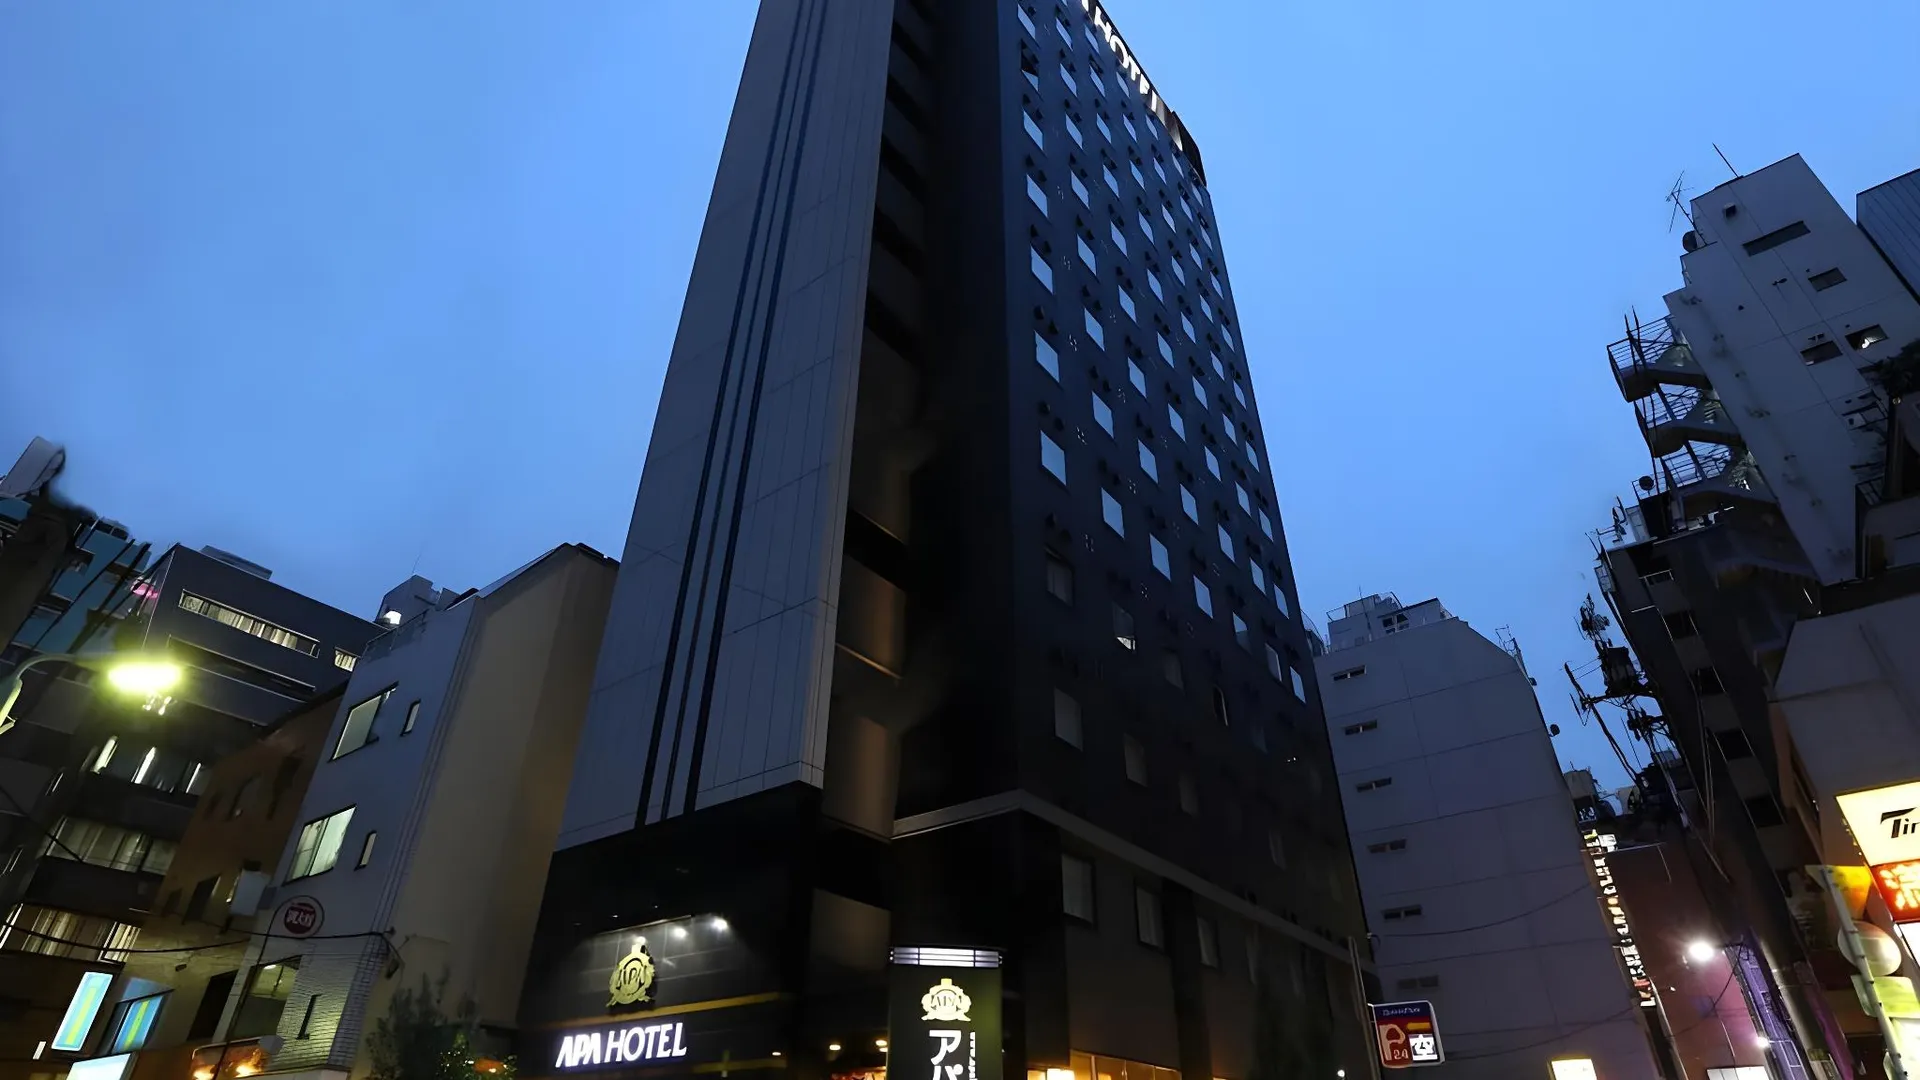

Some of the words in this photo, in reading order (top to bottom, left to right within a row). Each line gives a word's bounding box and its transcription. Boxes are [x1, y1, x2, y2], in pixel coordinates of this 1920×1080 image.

[555, 1032, 602, 1068] APA
[604, 1022, 688, 1063] HOTEL
[1379, 1024, 1405, 1061] P
